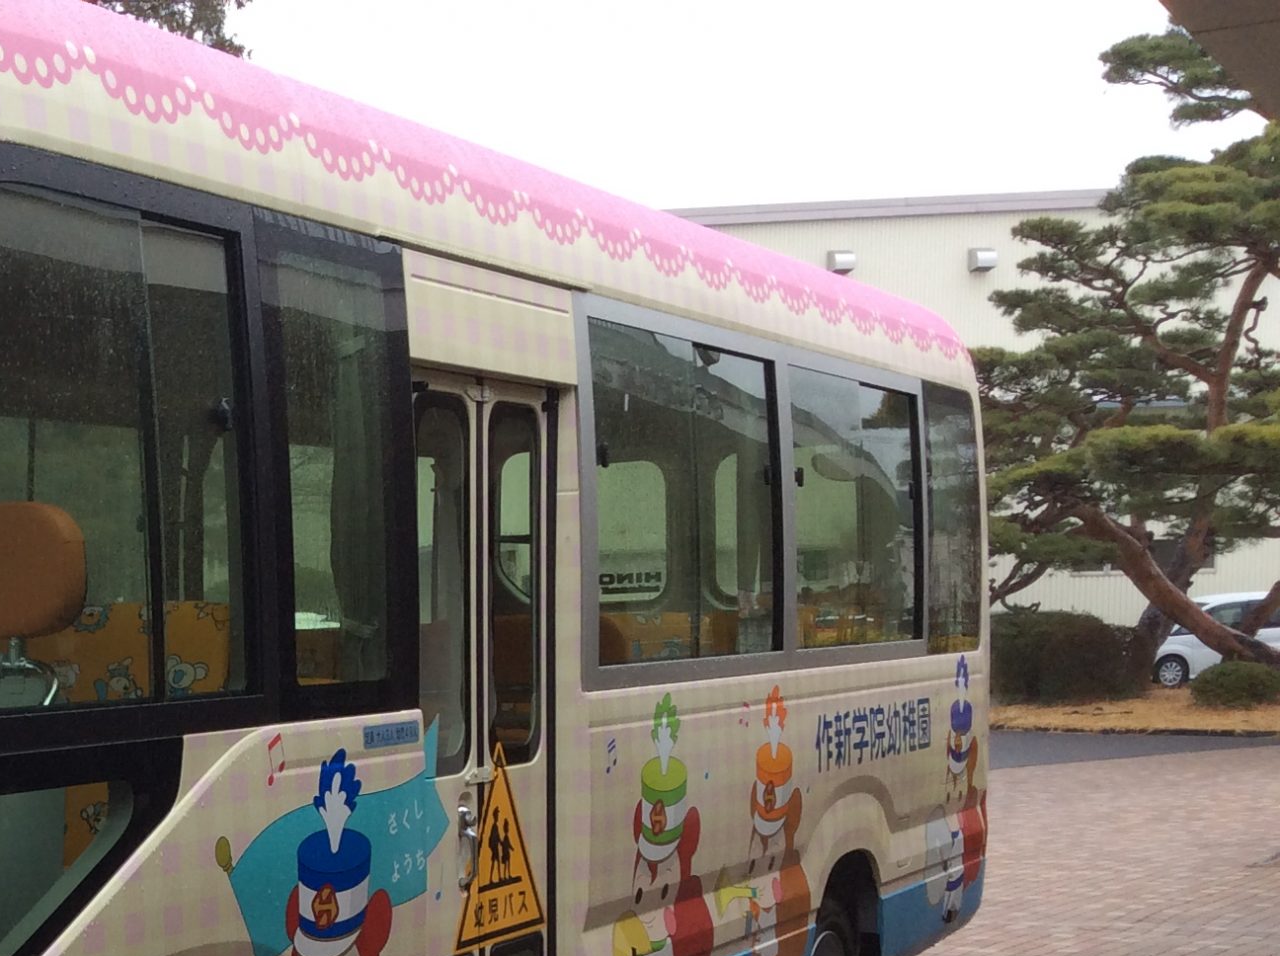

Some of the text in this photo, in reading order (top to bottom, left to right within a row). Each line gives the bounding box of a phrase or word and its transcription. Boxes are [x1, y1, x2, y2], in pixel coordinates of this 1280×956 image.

[815, 698, 932, 773] 作新学院幼稚園
